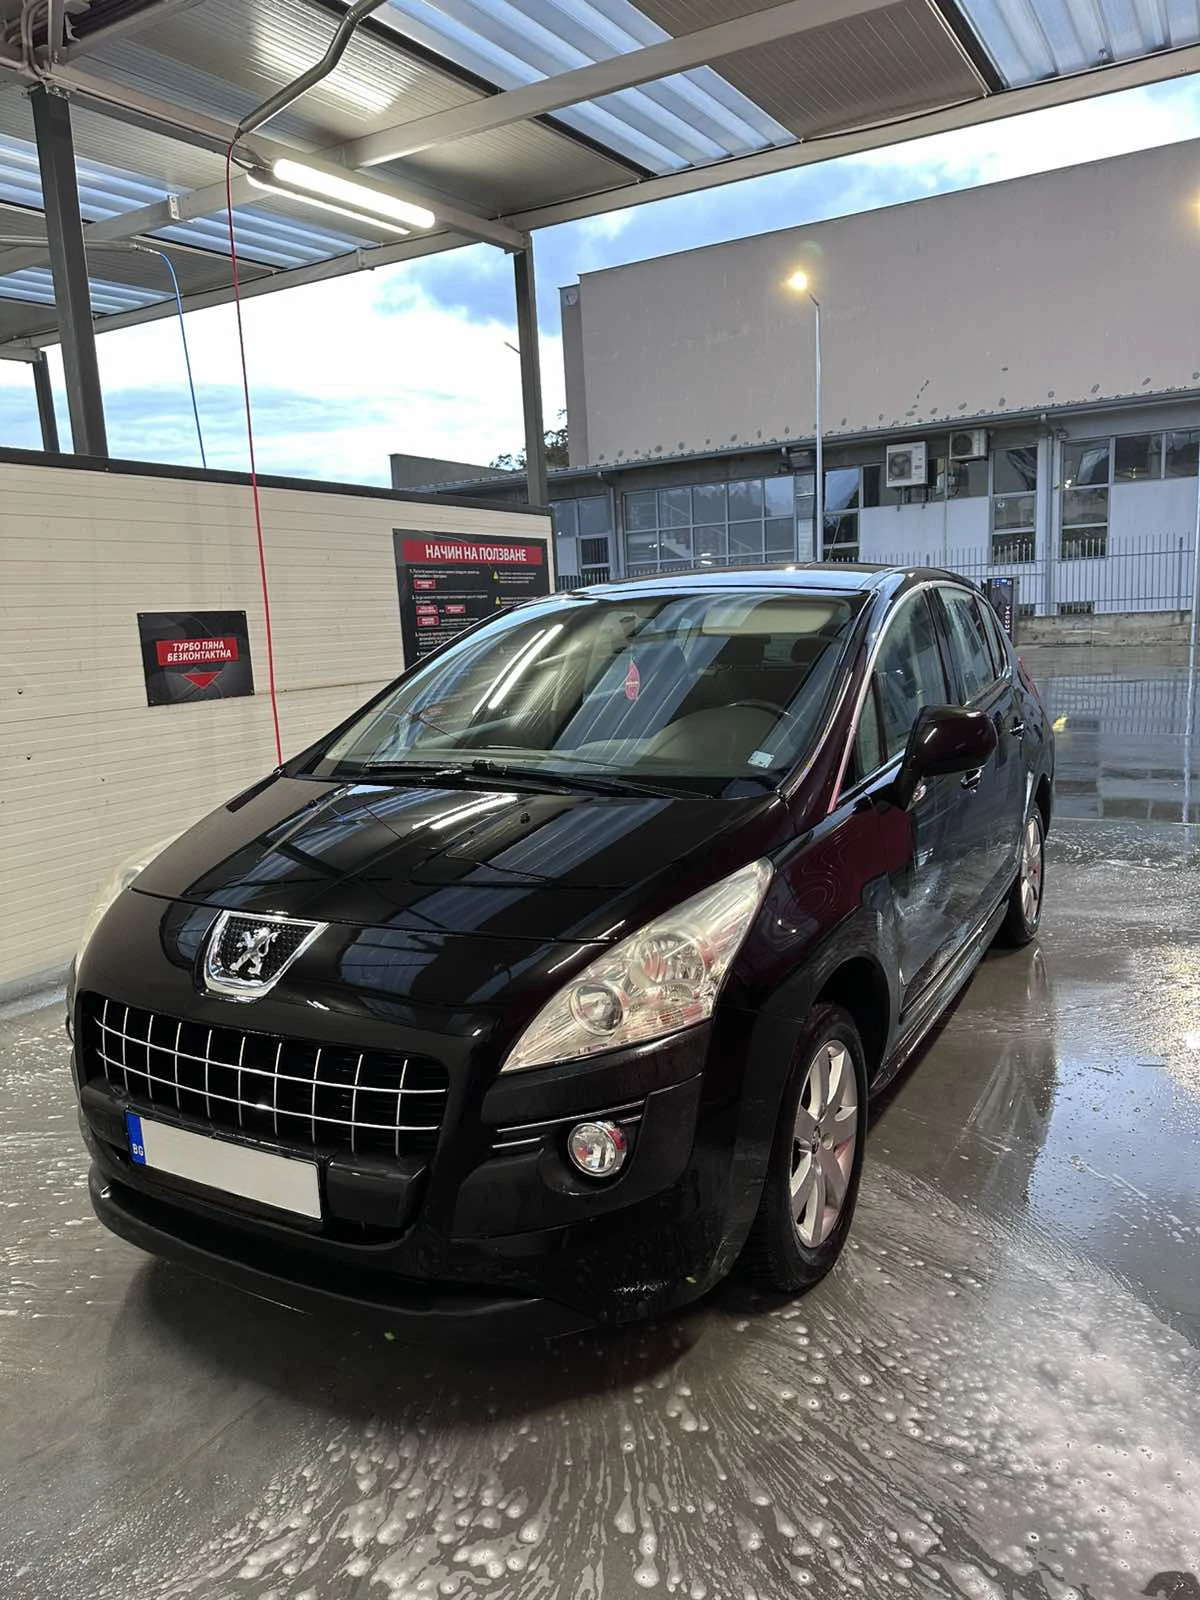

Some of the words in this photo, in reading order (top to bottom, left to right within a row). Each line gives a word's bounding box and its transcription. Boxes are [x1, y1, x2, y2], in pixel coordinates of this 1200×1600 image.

[425, 544, 462, 560] НАЧИН
[464, 546, 479, 561] НА
[480, 547, 527, 562] ПОЛЗВАНЕ
[173, 642, 201, 652] ТУРБО
[202, 641, 224, 650] ПЯНА
[167, 649, 232, 662] БЕЗКОНТАКТНА
[132, 1143, 144, 1156] BG
